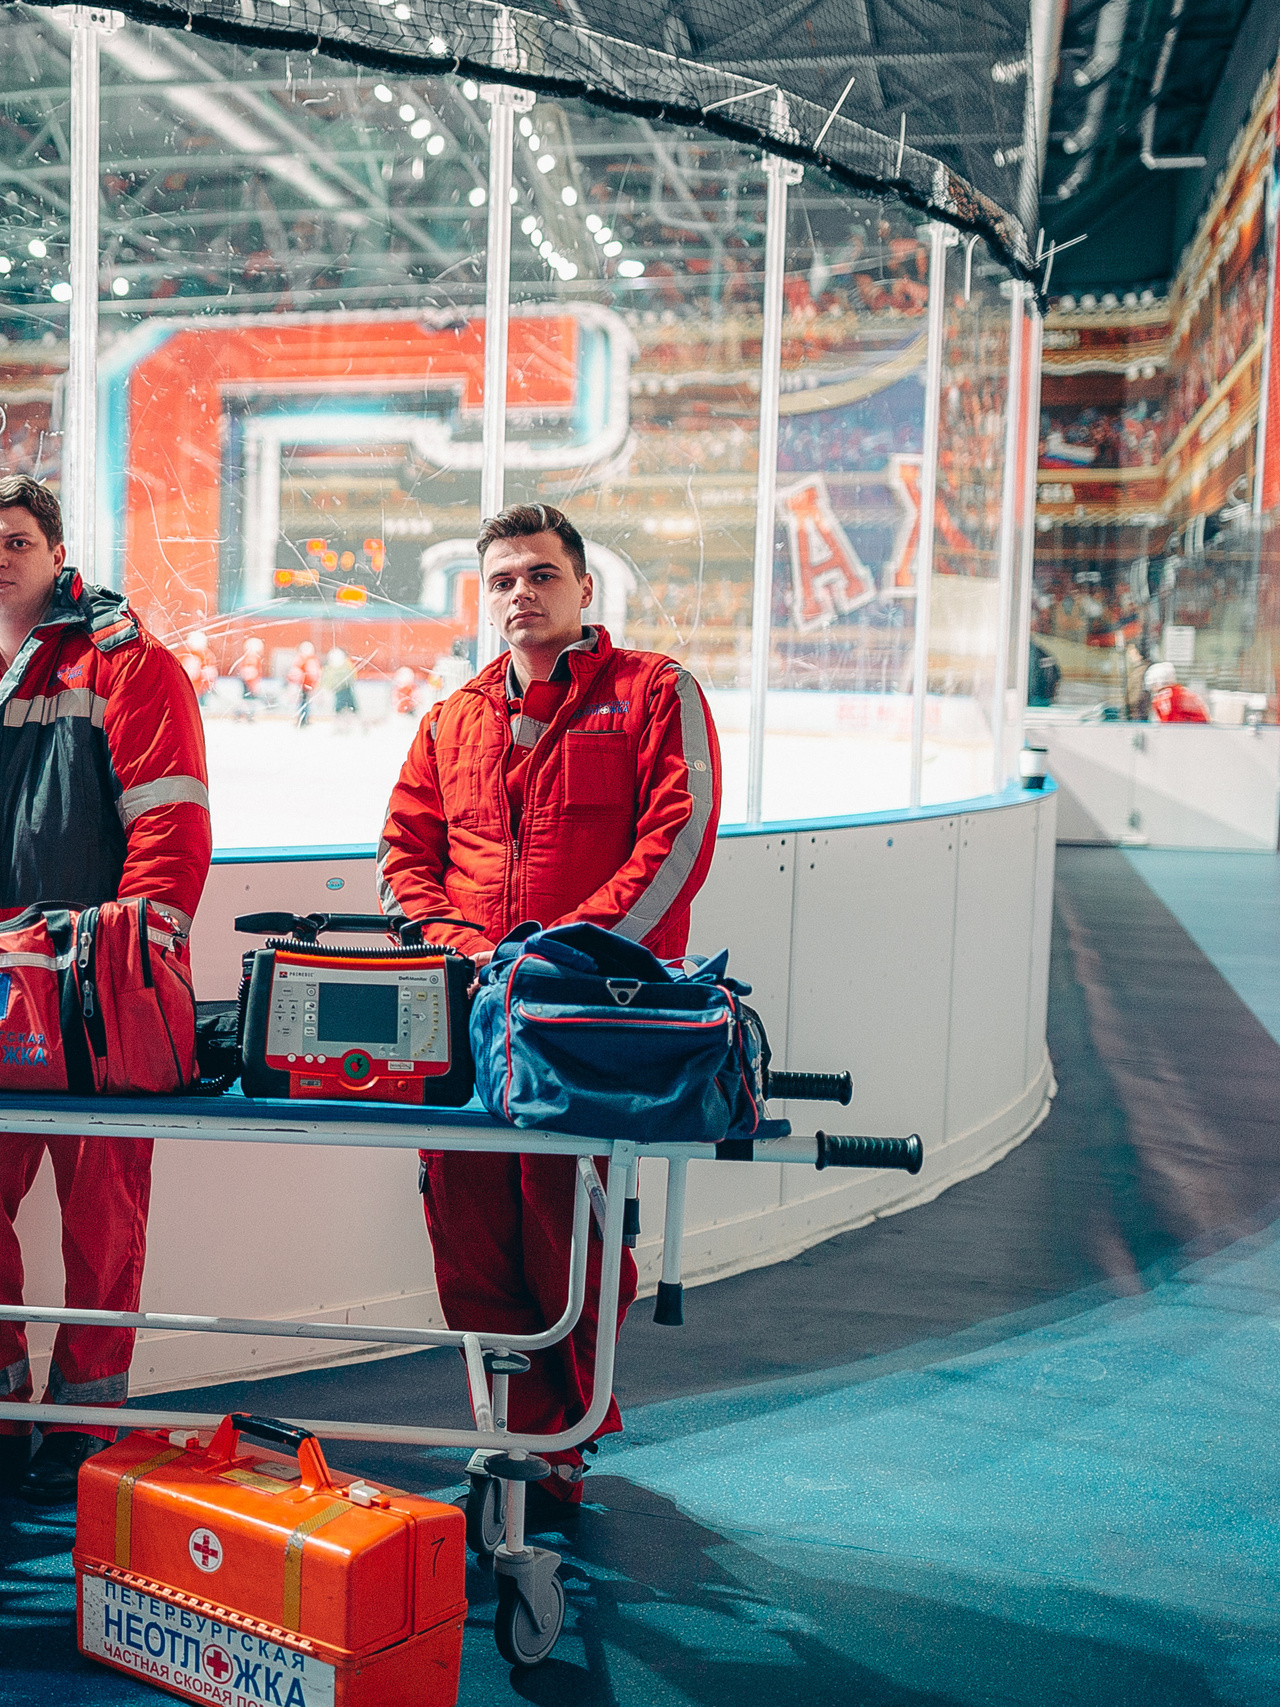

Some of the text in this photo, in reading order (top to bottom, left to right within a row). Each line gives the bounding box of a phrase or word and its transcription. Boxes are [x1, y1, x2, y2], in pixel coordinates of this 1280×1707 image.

[105, 1580, 306, 1673] ПЕТЕРБУРГСКАЯ
[103, 1641, 170, 1680] ЧАСТНАЯ
[173, 1670, 232, 1706] СКОРАЯ
